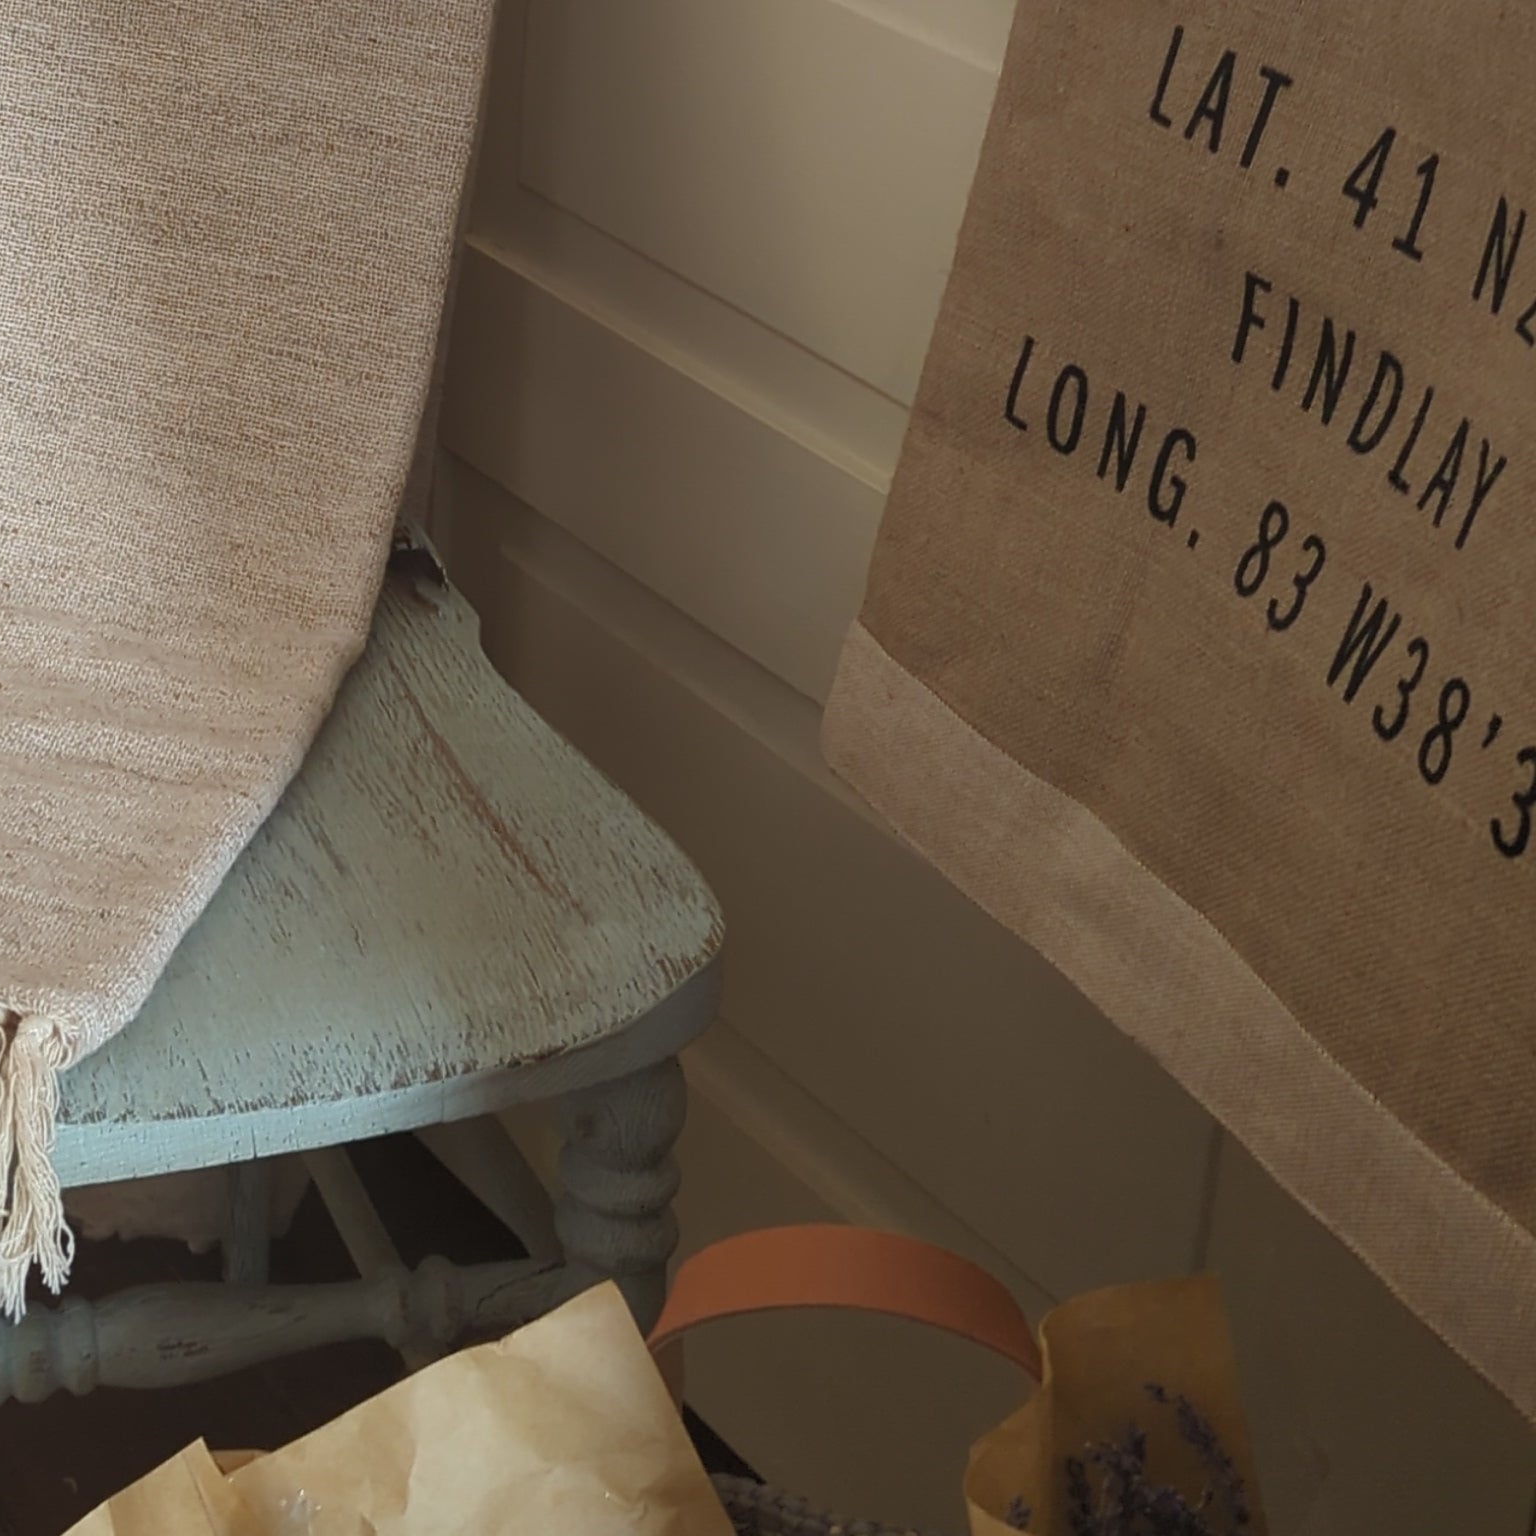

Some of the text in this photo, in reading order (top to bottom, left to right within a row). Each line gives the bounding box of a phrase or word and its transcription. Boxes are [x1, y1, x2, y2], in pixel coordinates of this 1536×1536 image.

[1148, 23, 1295, 190] LAT.
[1341, 126, 1440, 263] 41
[1002, 334, 1201, 552] LONG.
[1232, 498, 1328, 634] 83
[1230, 269, 1509, 552] FINDLAY
